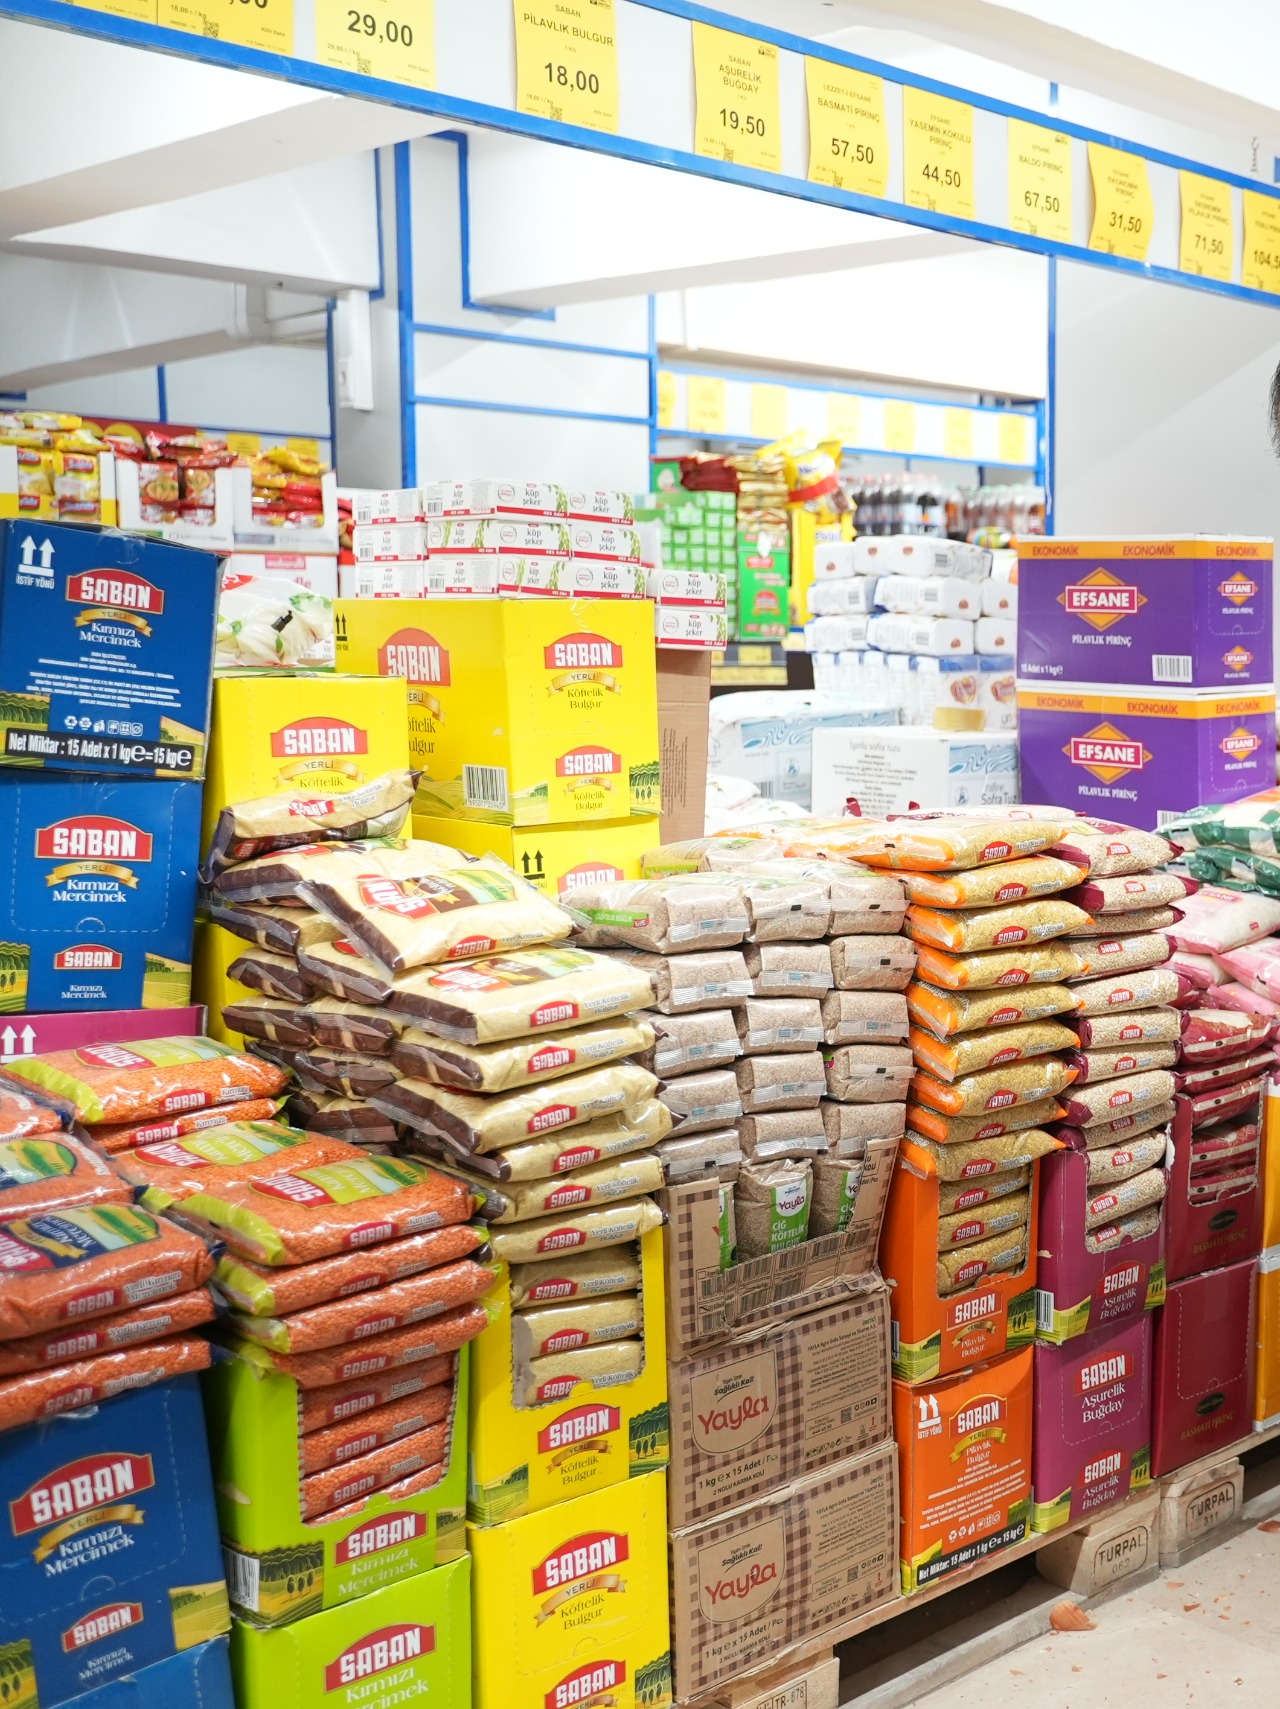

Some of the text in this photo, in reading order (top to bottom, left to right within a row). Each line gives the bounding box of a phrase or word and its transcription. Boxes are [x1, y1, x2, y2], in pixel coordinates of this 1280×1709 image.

[555, 4, 581, 18] SABAN
[347, 10, 413, 47] 29,00
[523, 12, 614, 47] PİLAVLIK BULGUR
[544, 62, 600, 94] 18,00
[719, 63, 762, 84] AŞURELİK
[723, 76, 759, 94] BUĞDAY
[817, 97, 880, 124] BASMATİ PİRİNÇ
[719, 107, 765, 137] 19,50
[942, 129, 972, 144] KOKULU
[831, 137, 874, 164] 57,50
[922, 163, 961, 188] 44,50
[1024, 190, 1060, 213] 67,50
[1110, 211, 1142, 234] 31,50
[1194, 234, 1224, 255] 71,50
[525, 487, 540, 498] küp
[601, 535, 615, 545] küp
[1032, 545, 1079, 556] EKONOMİK
[1122, 543, 1175, 556] EKONOMİK
[1215, 545, 1259, 557] EKONOMİK
[16, 573, 54, 589] İSTİF YÖNÜ
[603, 571, 618, 582] küp
[80, 577, 151, 609] SABAN
[1072, 592, 1130, 607] EFSANE
[1224, 584, 1251, 594] EFSANE
[79, 630, 142, 648] Mercimek
[92, 622, 136, 637] Kırmızı
[1072, 634, 1105, 645] PİLAVLIK
[554, 642, 612, 667] SABAN
[570, 672, 597, 682] YERLİ
[567, 687, 604, 699] Köftelik
[569, 698, 602, 710] Bulgur
[1036, 696, 1084, 709] EKONOMİK
[1127, 702, 1178, 715] EKONOMİK
[1215, 701, 1261, 714] EKONOMİK
[9, 733, 102, 758] Net Miktar 15 Adet
[283, 727, 355, 755] SABAN
[408, 736, 435, 755] ulgur
[1226, 738, 1254, 749] EFSANE
[303, 760, 335, 770] YERLİ
[564, 752, 613, 775] SABAN
[1078, 745, 1135, 763] EFSANE
[299, 775, 345, 788] Köftelik
[1078, 786, 1110, 797] PİLAVLIK
[573, 790, 605, 802] Köftelik
[574, 800, 604, 812] Bulgur
[53, 828, 137, 857] SABAN
[67, 879, 119, 891] Kırmızı
[53, 890, 127, 903] Mercimek
[64, 951, 114, 967] SABAN
[61, 990, 107, 999] Mercimek
[536, 1003, 574, 1026] SABAN
[532, 1049, 570, 1071] SABAN
[164, 1091, 206, 1112] SABAN
[533, 1107, 571, 1130] SABAN
[136, 1123, 179, 1145] SABAN
[559, 1150, 596, 1169] SABAN
[551, 1189, 587, 1208] SABAN
[779, 1196, 805, 1210] Yayla
[958, 1191, 984, 1207] SABAN
[1093, 1197, 1115, 1213] SABAN
[350, 1223, 392, 1248] SABAN
[544, 1231, 580, 1252] SABAN
[956, 1224, 981, 1241] SABAN
[959, 1262, 983, 1281] SABAN
[1103, 1265, 1140, 1293] SABAN
[535, 1283, 572, 1299] SABAN
[1101, 1288, 1137, 1309] Aşurelik
[66, 1290, 115, 1317] SABAN
[955, 1293, 996, 1324] SABAN
[1100, 1300, 1135, 1320] Buğday
[355, 1316, 396, 1338] SABAN
[547, 1332, 584, 1351] SABAN
[343, 1355, 386, 1378] SABAN
[1081, 1354, 1126, 1390] SABAN
[333, 1393, 375, 1419] SABAN
[1081, 1383, 1125, 1409] Aşurelik
[698, 1395, 769, 1435] Yayla
[957, 1401, 1000, 1433] SABAN
[1082, 1399, 1125, 1424] Buğday
[550, 1408, 610, 1447] SABAN
[917, 1428, 930, 1439] İSTİF
[336, 1433, 377, 1461] SABAN
[966, 1440, 992, 1456] Pilavlık
[966, 1450, 991, 1465] Bulgur
[560, 1455, 599, 1475] Köftelik
[706, 1459, 762, 1488] kg 15 Adet
[1083, 1452, 1121, 1484] SABAN
[562, 1468, 597, 1485] Bulgur
[1083, 1476, 1120, 1499] Aşurelik
[30, 1460, 135, 1524] SABAN
[334, 1475, 375, 1502] SABAN
[1082, 1487, 1118, 1510] Buğday
[1189, 1489, 1233, 1520] TURPAL
[59, 1525, 124, 1558] Kırmızı
[348, 1515, 416, 1558] SABAN
[44, 1533, 135, 1577] Mercimek
[1098, 1533, 1145, 1565] TURPAL
[351, 1547, 409, 1576] Kırmızı
[545, 1536, 617, 1587] SABAN
[919, 1568, 929, 1580] Net
[950, 1556, 958, 1567] 15
[1112, 1558, 1130, 1574] 062
[338, 1560, 418, 1598] Mercimek
[566, 1577, 596, 1597] YERLİ
[705, 1561, 777, 1605] Yayla
[560, 1593, 606, 1618] Köftelik
[73, 1605, 132, 1646] SABAN
[563, 1606, 604, 1630] Bulgur
[712, 1627, 767, 1657] kg 15 Adet
[78, 1652, 134, 1680] Mercimek
[340, 1628, 421, 1683] SABAN
[345, 1667, 416, 1703] Kırmızı
[556, 1663, 616, 1708] SABAN
